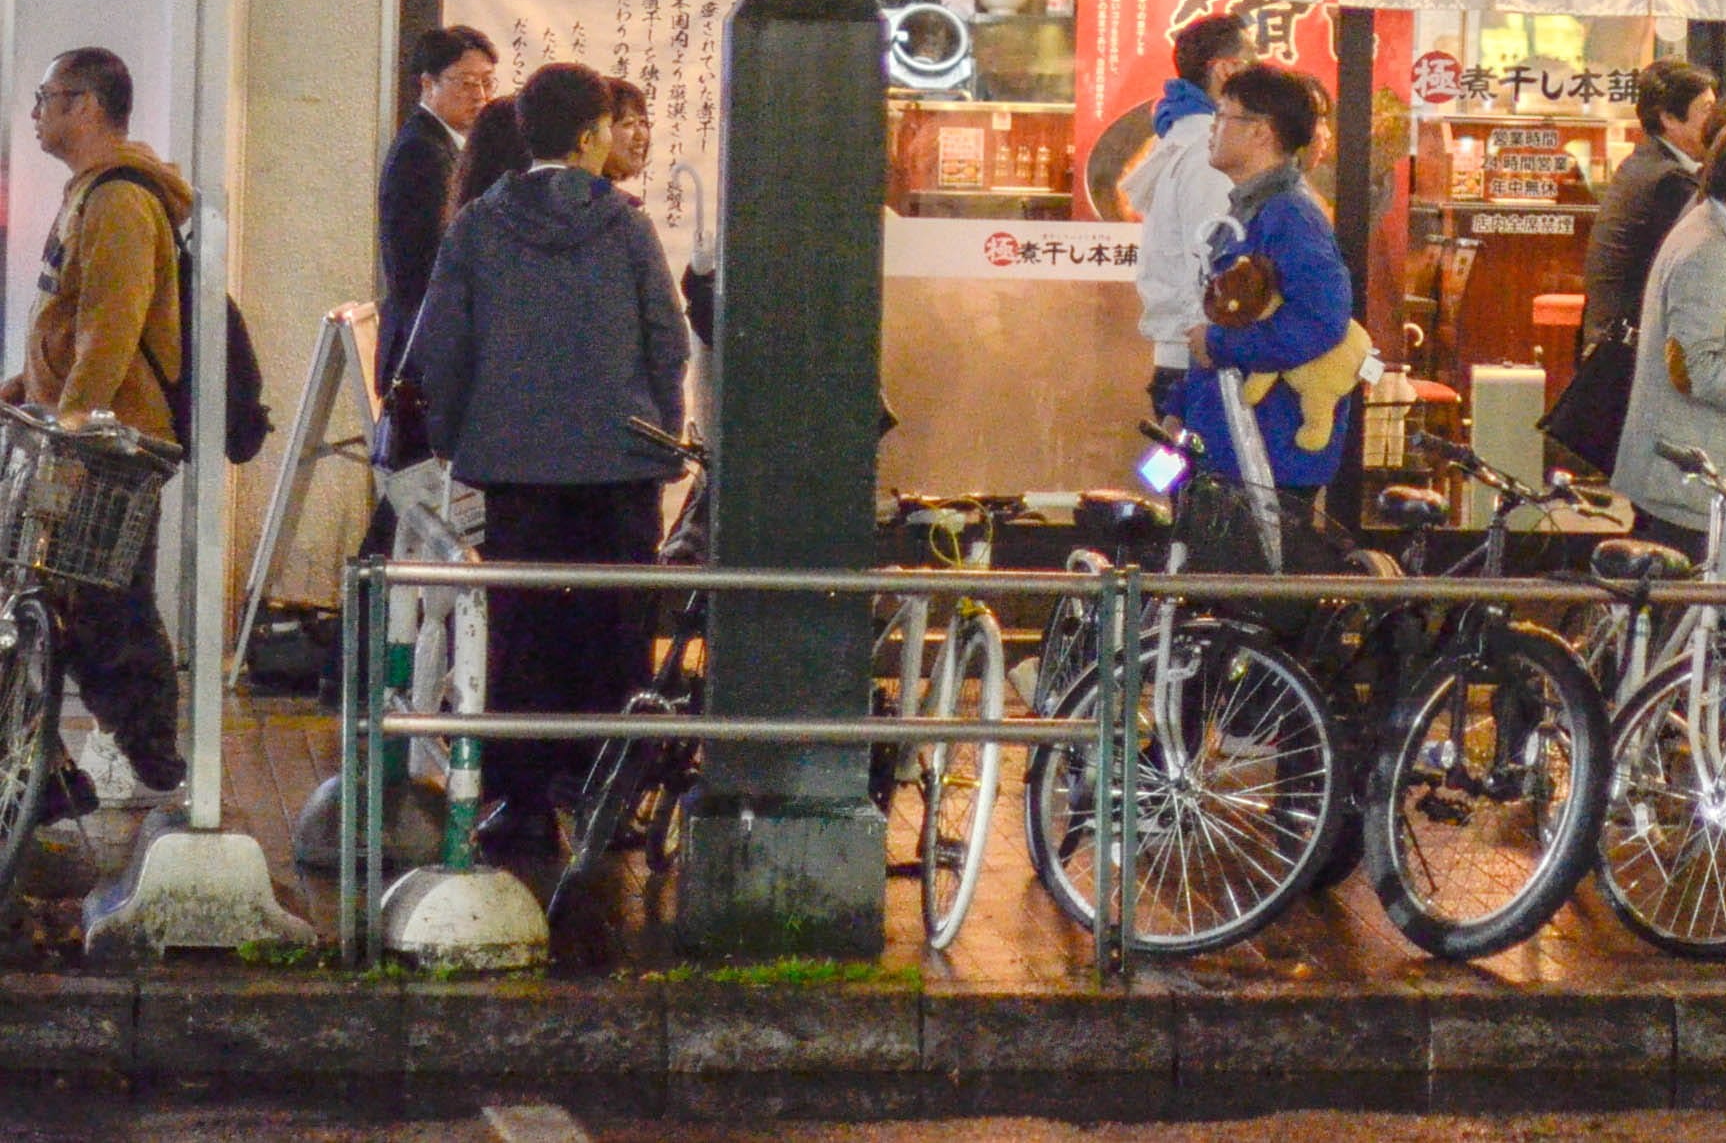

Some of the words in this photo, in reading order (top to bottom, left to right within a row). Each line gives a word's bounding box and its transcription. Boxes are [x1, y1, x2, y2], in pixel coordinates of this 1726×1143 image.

[1412, 59, 1462, 99] 極
[1016, 241, 1140, 266] 煮干し本舗
